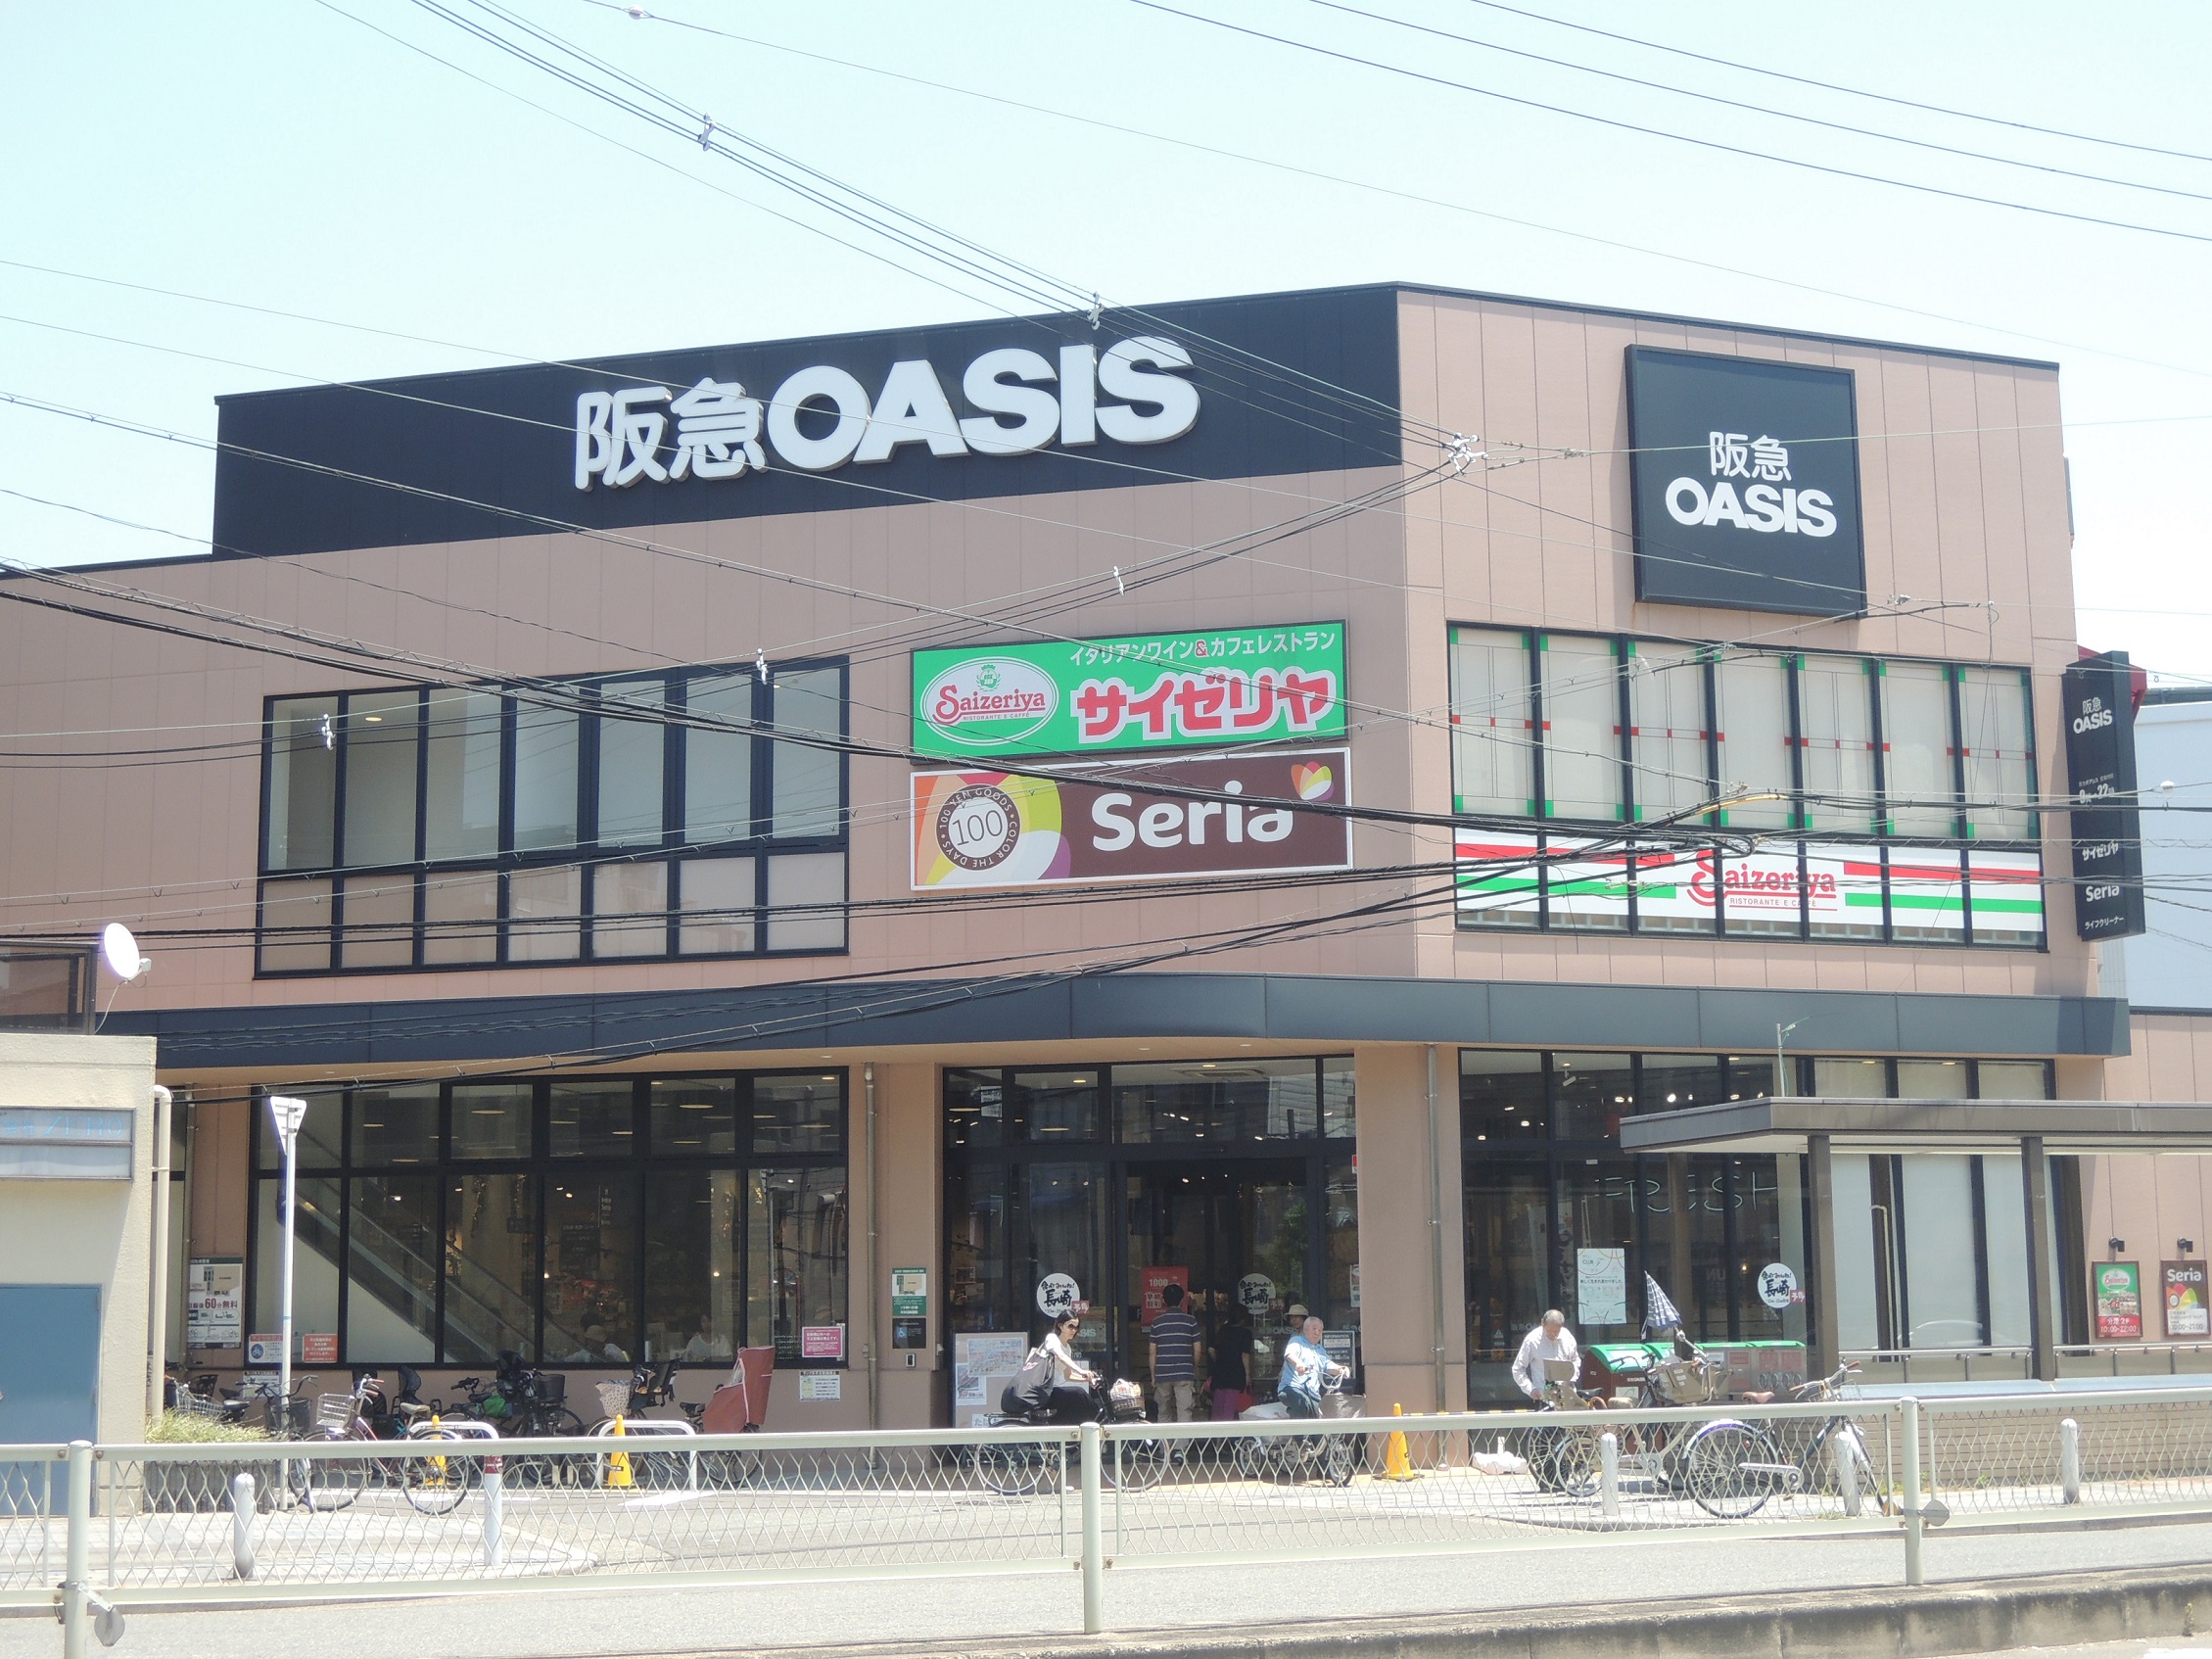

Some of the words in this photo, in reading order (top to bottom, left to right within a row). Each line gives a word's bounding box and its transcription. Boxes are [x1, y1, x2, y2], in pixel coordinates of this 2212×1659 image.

[1710, 431, 1791, 481] 阪急
[1666, 477, 1837, 538] OASIS
[935, 685, 1046, 720] Saizeriya
[1074, 670, 1332, 739] サイゼリヤ
[2082, 696, 2102, 716] 阪急
[2073, 709, 2113, 735] OASIS
[975, 788, 1012, 812] GOODS
[952, 810, 1003, 846] 100
[1091, 780, 1294, 851] Seria
[996, 821, 1017, 859] COLOR
[2082, 842, 2119, 862] サイゼリヤ
[942, 840, 967, 866] DAYS
[972, 857, 995, 868] THE
[1688, 848, 1836, 899] Saizerya
[2085, 884, 2120, 903] Seria
[2085, 916, 2125, 930] ライフクリーナー
[2167, 1266, 2202, 1282] Seria
[1044, 1288, 1073, 1308] 長崎
[1242, 1287, 1269, 1304] 長崎
[1765, 1279, 1790, 1298] 長崎
